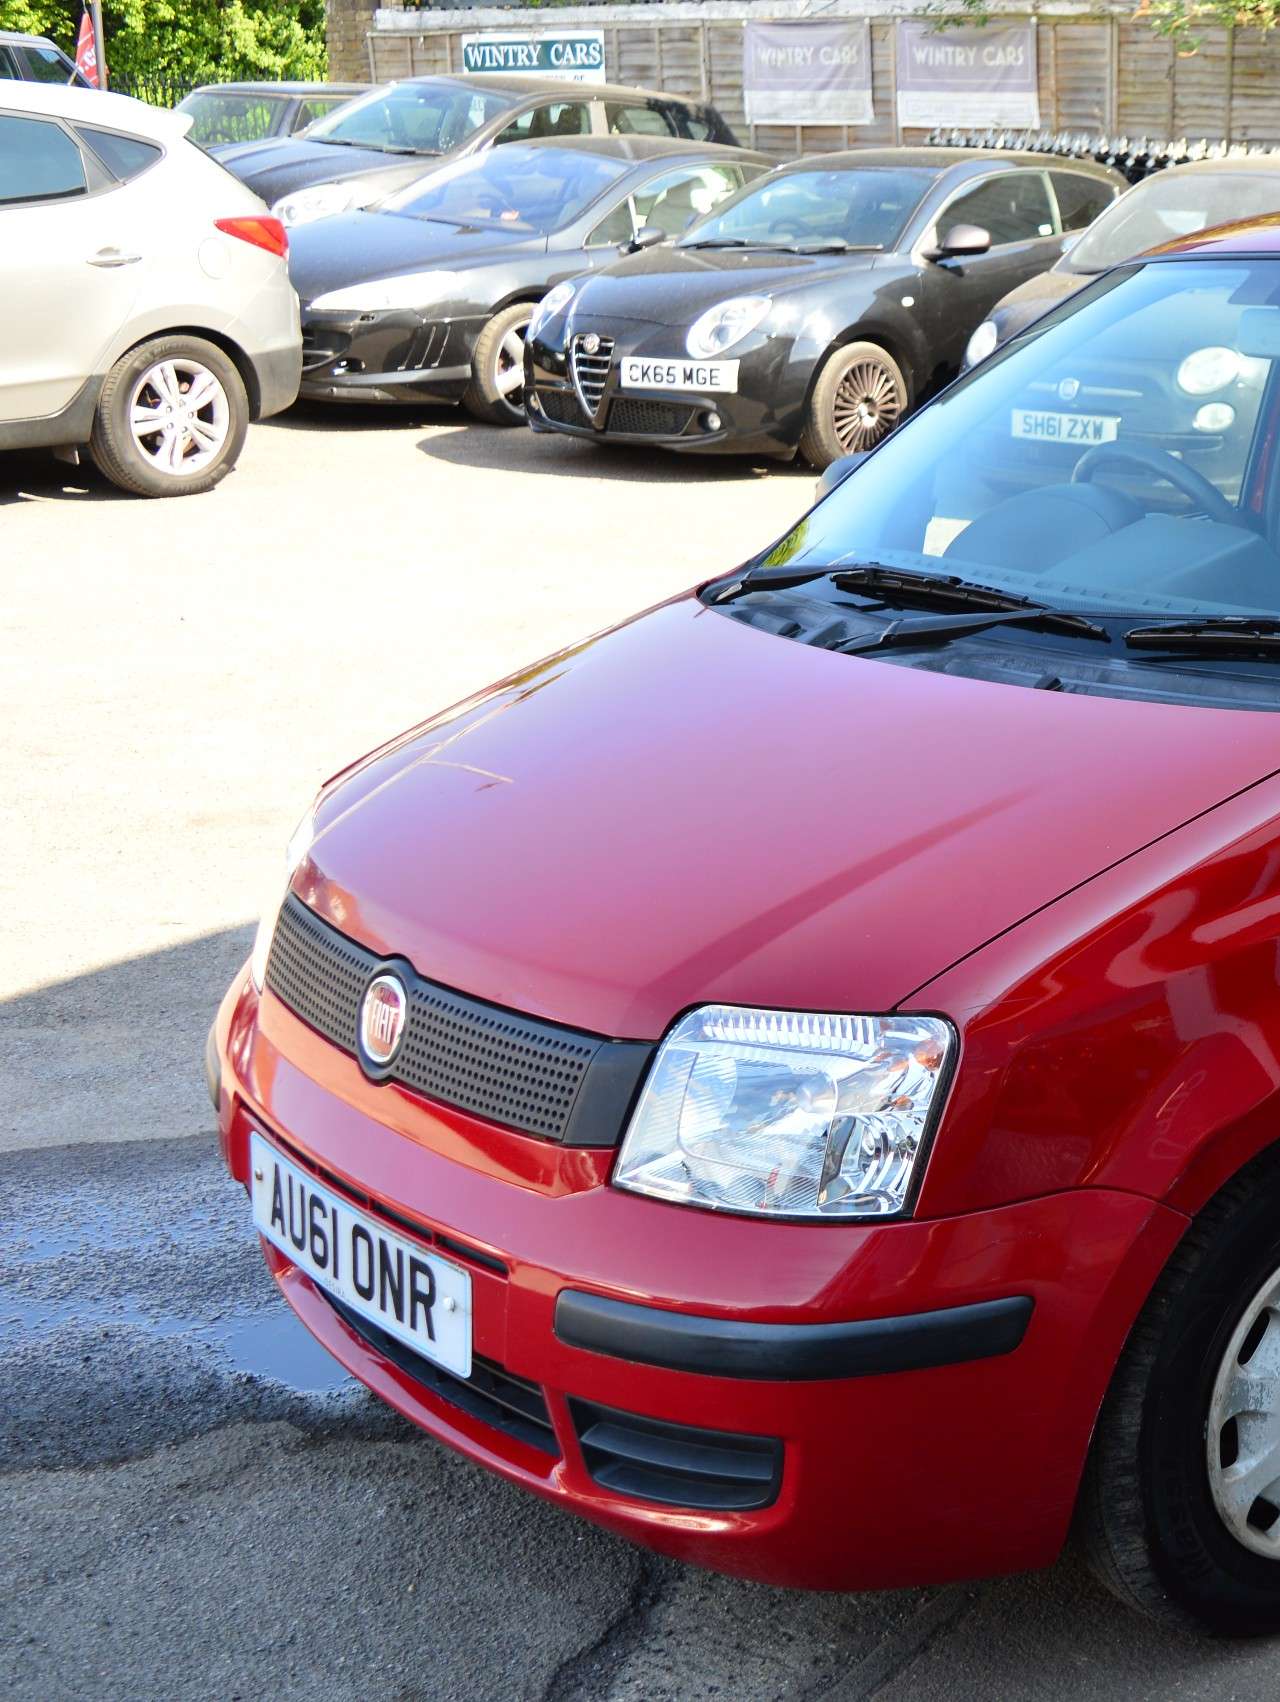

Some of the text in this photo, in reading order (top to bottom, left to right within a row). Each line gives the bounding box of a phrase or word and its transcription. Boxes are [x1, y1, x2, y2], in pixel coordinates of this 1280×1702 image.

[467, 42, 601, 67] WINTRY CARS
[758, 45, 859, 66] WINTRY CARS
[912, 45, 1024, 66] WINTRY CARS
[629, 364, 721, 386] CK65 MGE
[1067, 418, 1104, 440] ZXW
[369, 998, 401, 1044] FIAT
[270, 1162, 436, 1342] AU61 ONR
